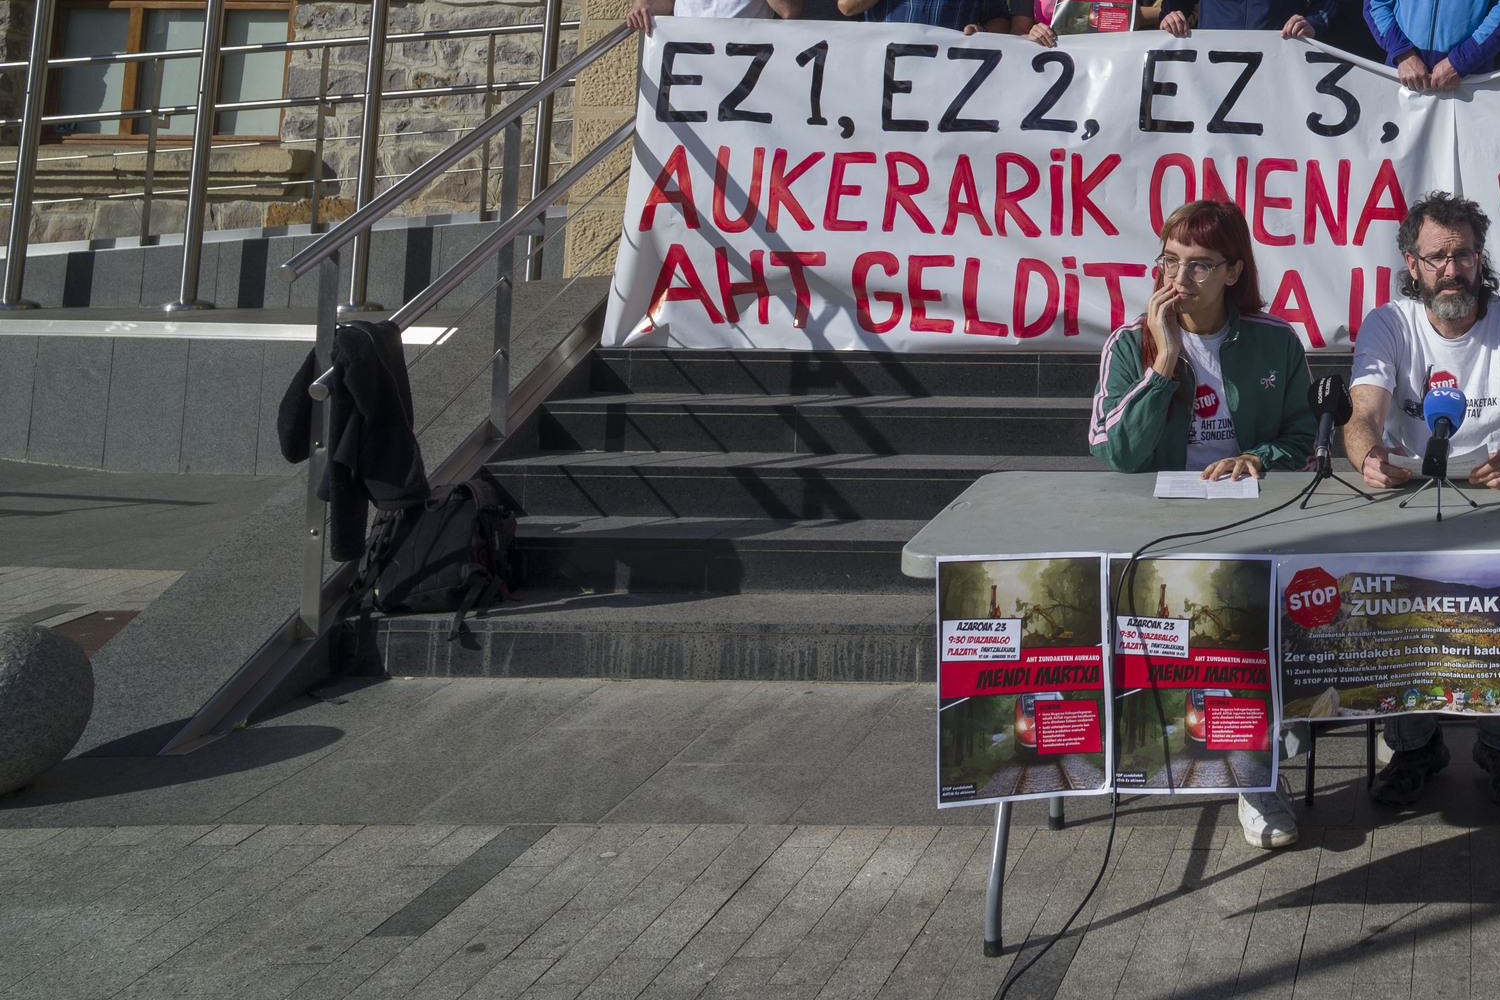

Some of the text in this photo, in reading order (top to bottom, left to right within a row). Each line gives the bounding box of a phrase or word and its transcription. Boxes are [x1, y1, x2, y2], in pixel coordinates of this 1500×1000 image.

[655, 39, 1400, 143] EZ 1, EZ 2, EZ 3,
[1149, 152, 1409, 246] ONENA
[640, 242, 826, 333] AHT
[1430, 379, 1455, 390] STOP
[1193, 393, 1216, 410] STOP
[1433, 390, 1460, 400] tve
[1468, 408, 1482, 418] TAV
[1201, 419, 1217, 430] AHT
[1350, 576, 1395, 593] AHT
[1289, 586, 1337, 611] STOP
[1351, 596, 1500, 616] ZUNDAKETAK
[956, 622, 1006, 631] AZAROAK 23
[1127, 618, 1175, 630] AZAROAK 23
[1120, 630, 1136, 638] 9:30
[1284, 652, 1305, 662] Zer
[1309, 652, 1335, 663] egin
[1338, 648, 1401, 660] zundaketa
[1405, 645, 1438, 655] baten
[1442, 645, 1470, 655] berri
[1147, 664, 1267, 684] MENDI MARTXA
[1378, 661, 1426, 670] harremanetan
[976, 665, 1100, 689] MENDI MARTXA
[1340, 674, 1388, 683] ZUNDAKETAK
[1391, 671, 1436, 679] ekimenarekin
